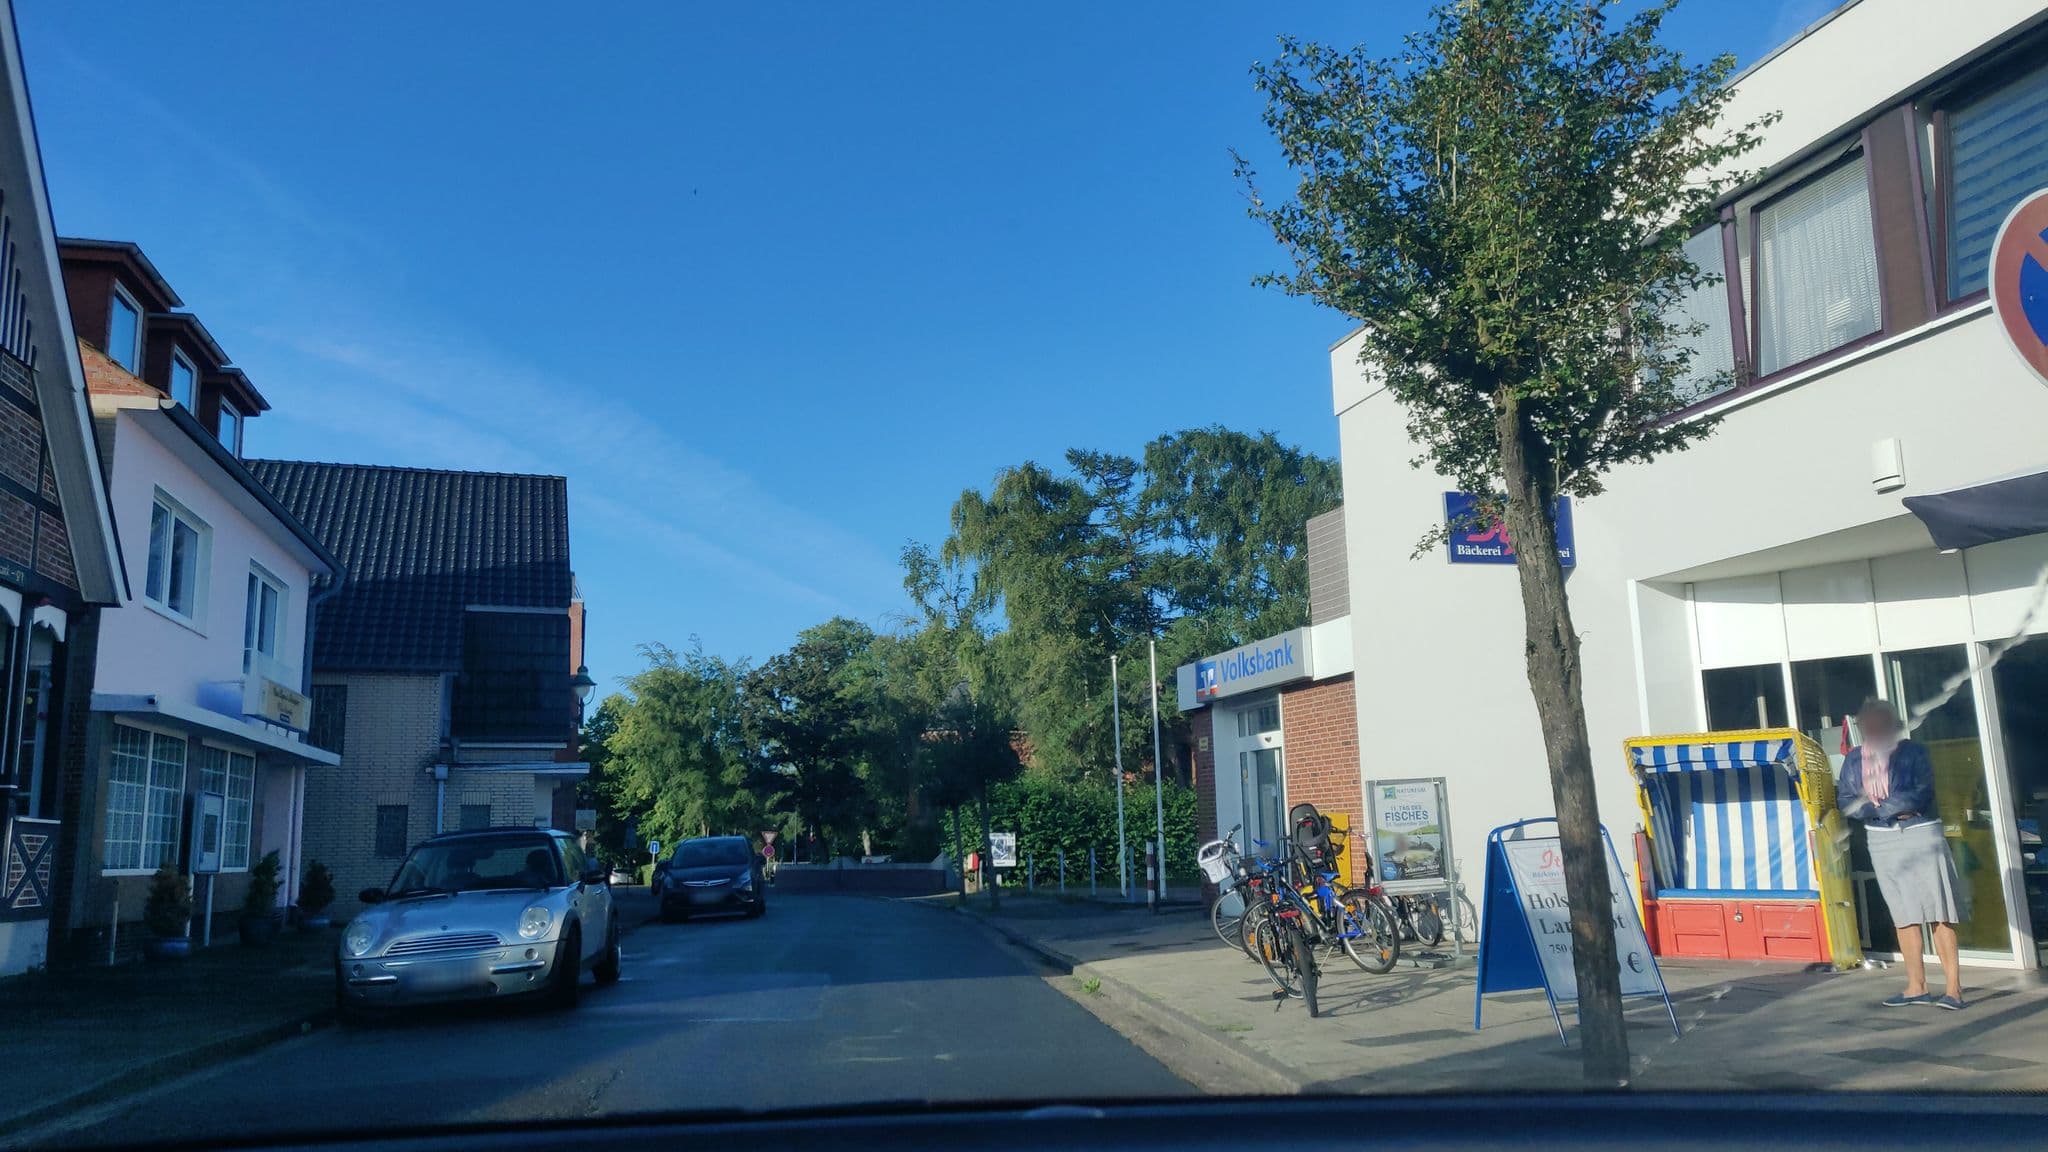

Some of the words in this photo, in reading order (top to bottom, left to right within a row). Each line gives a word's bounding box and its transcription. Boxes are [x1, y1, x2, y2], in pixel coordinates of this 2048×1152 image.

[1457, 544, 1501, 556] Bäckerei
[1220, 637, 1294, 683] Volksbank
[1384, 810, 1429, 822] FISCHES
[1549, 943, 1568, 954] 750
[1627, 951, 1643, 974] €
